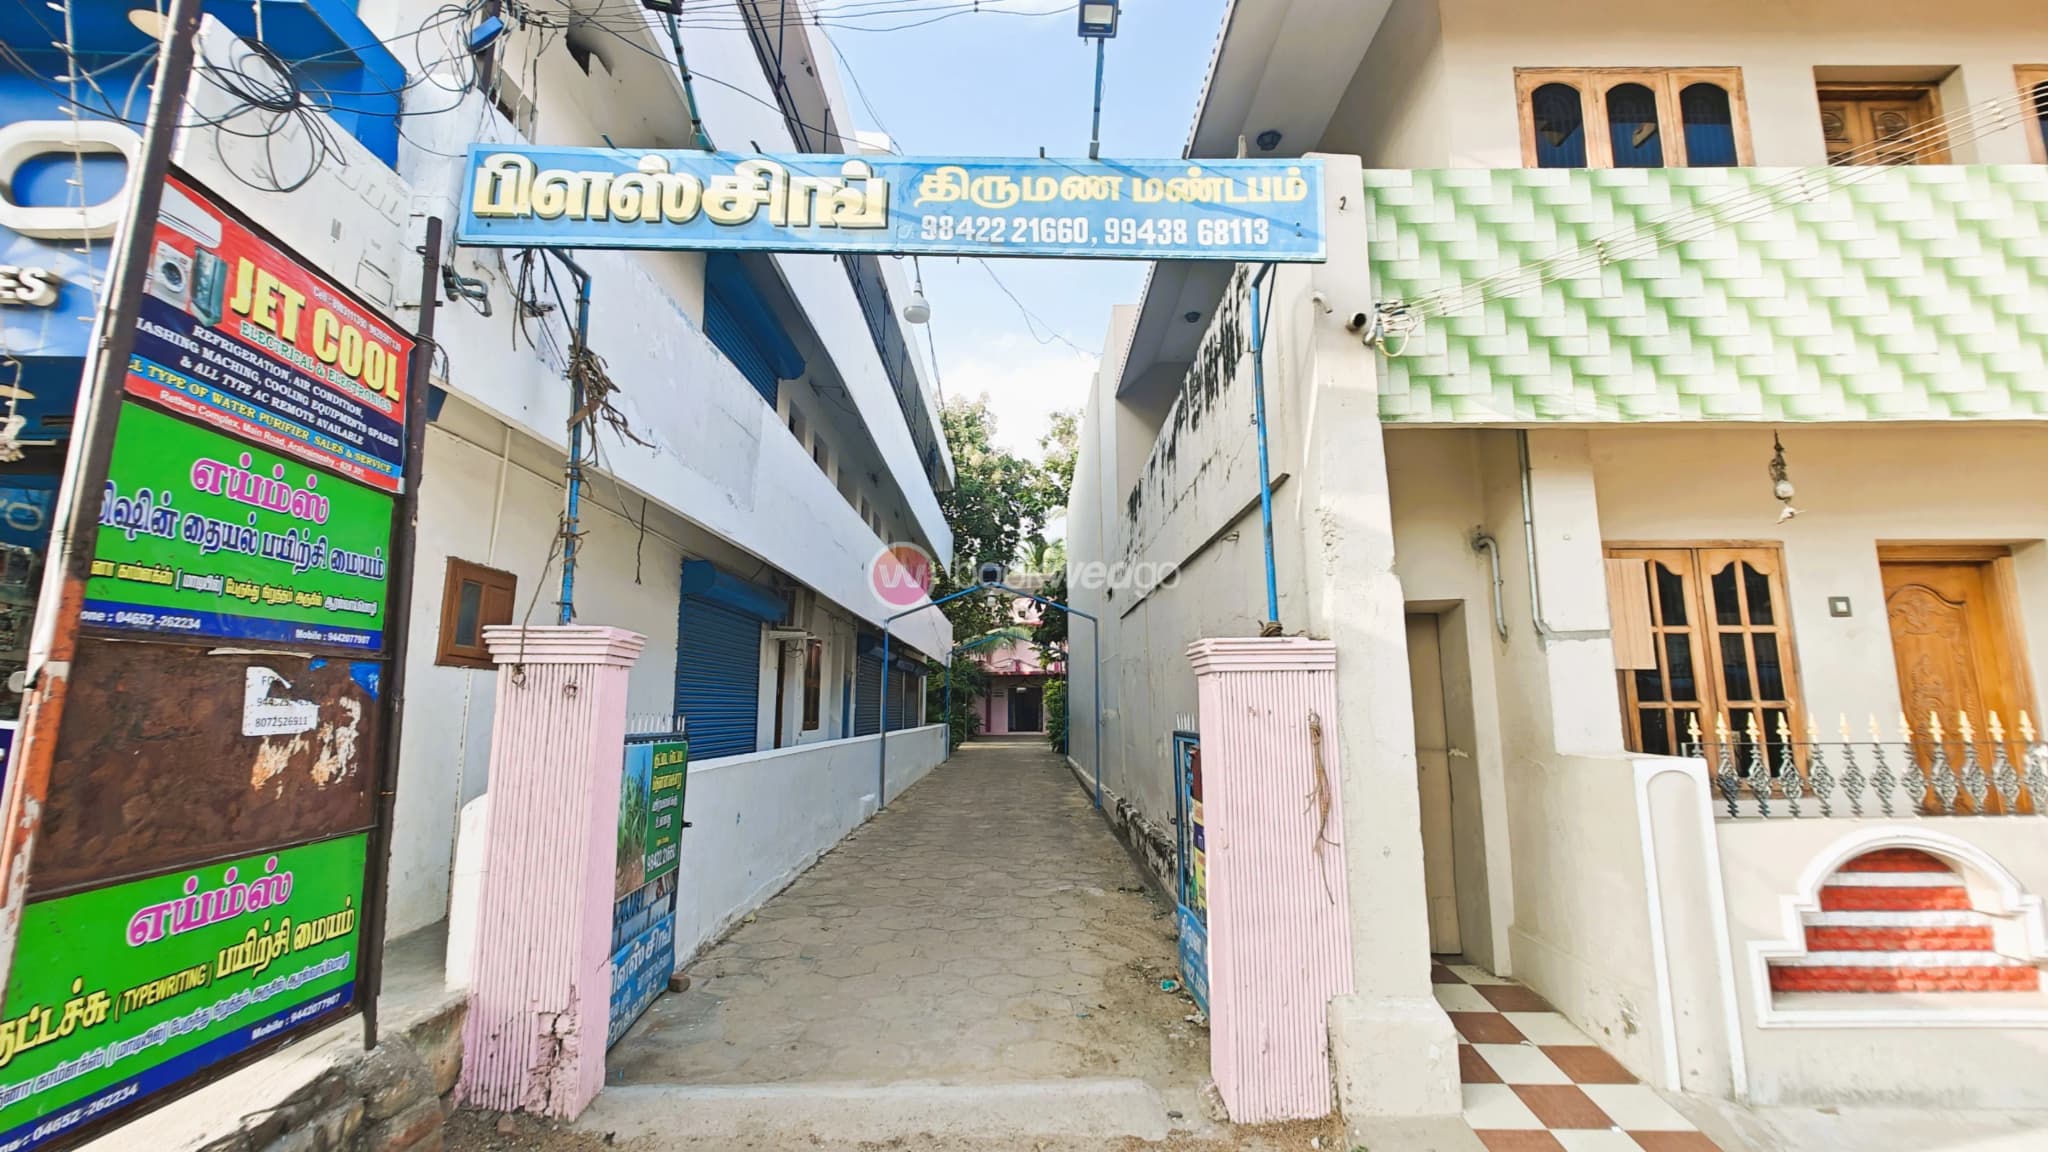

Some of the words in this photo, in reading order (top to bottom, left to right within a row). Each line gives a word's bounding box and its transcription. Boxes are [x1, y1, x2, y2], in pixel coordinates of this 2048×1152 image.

[914, 165, 1123, 208] திருமண
[1131, 166, 1308, 204] மண்டபம்
[921, 215, 1006, 243] 98422
[1104, 218, 1188, 245] 99438
[1197, 219, 1270, 246] 68113
[192, 325, 292, 383] REFRIGERATION,
[293, 377, 311, 392] AIR
[313, 386, 363, 418] CONDITION,
[230, 256, 305, 343] JET
[313, 307, 400, 402] COOL
[240, 320, 314, 371] ELECTRICAL
[327, 369, 393, 413] ELECTRONICS
[136, 317, 200, 353] ASHING
[202, 347, 261, 385] MACHING,
[264, 378, 310, 406] COOLING
[311, 401, 367, 433] EQUIPMENTS
[367, 427, 399, 447] SPARES
[148, 365, 187, 389] TYPE
[189, 383, 208, 398] OF
[212, 392, 257, 418] WATER
[259, 412, 310, 440] PURIFIER
[314, 435, 344, 455] SALES
[354, 452, 392, 473] SERVICE
[180, 356, 192, 368] &
[193, 363, 219, 381] ALL
[222, 374, 253, 396] TYPE
[253, 392, 270, 403] AC
[271, 397, 315, 423] REMOTE
[315, 418, 364, 445] AVAILABLE
[190, 452, 330, 525] எய்ம்ஸ்
[182, 512, 259, 555] தையல்
[260, 528, 327, 573] பயிற்சி
[330, 547, 386, 580] மையம்
[295, 629, 321, 641] Mobile
[127, 856, 294, 947] எய்ம்ஸ்
[216, 917, 290, 979] பயிற்சி
[293, 894, 355, 951] மையம்
